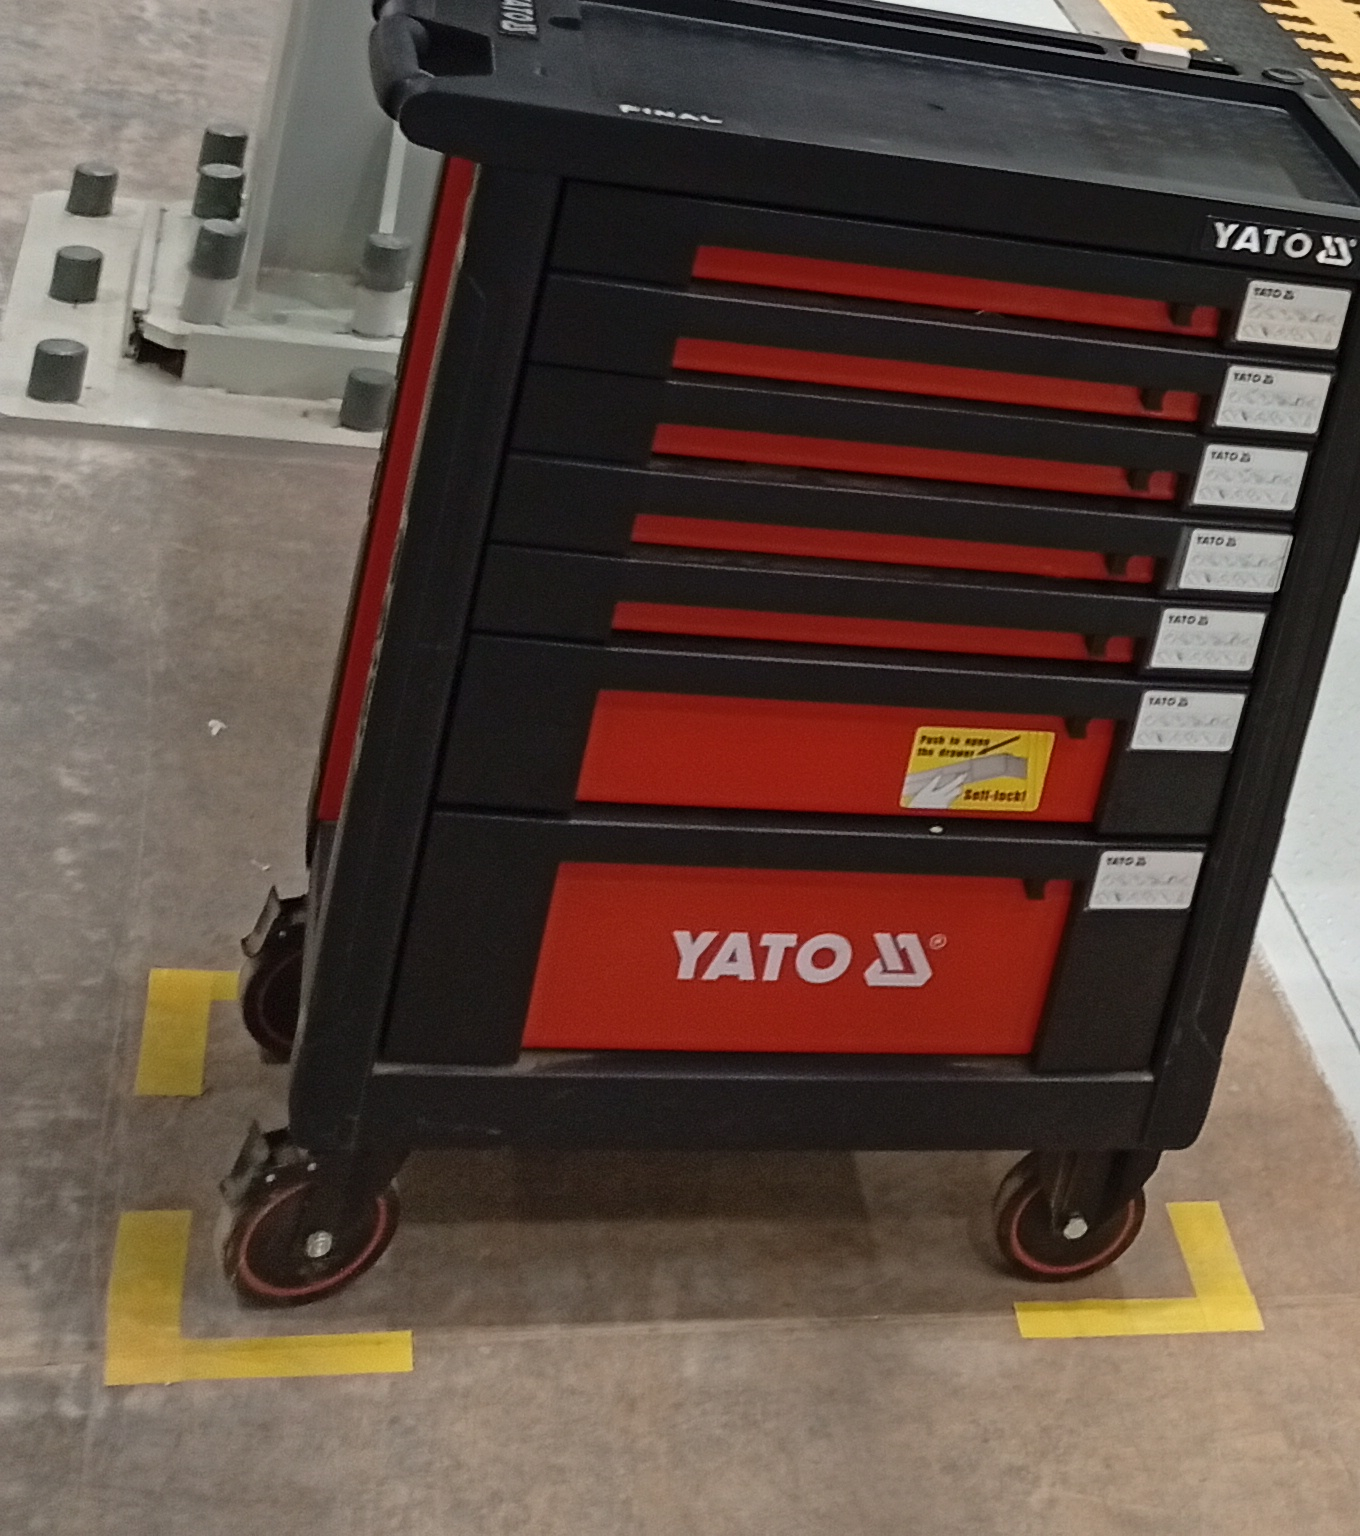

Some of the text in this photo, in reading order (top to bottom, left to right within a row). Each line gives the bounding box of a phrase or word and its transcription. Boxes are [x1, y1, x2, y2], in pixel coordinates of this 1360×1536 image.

[618, 104, 723, 124] FINAL
[1214, 222, 1313, 259] YATO
[1254, 287, 1282, 299] YATO
[1233, 372, 1261, 383] YATO
[1210, 451, 1238, 462] YATO
[1196, 536, 1225, 546] YATO
[1168, 615, 1196, 625] YATO
[1149, 697, 1176, 707] YATO
[920, 735, 945, 745] Push
[917, 748, 975, 757] the drawer
[1106, 857, 1134, 866] YATO
[673, 930, 852, 984] YATO
